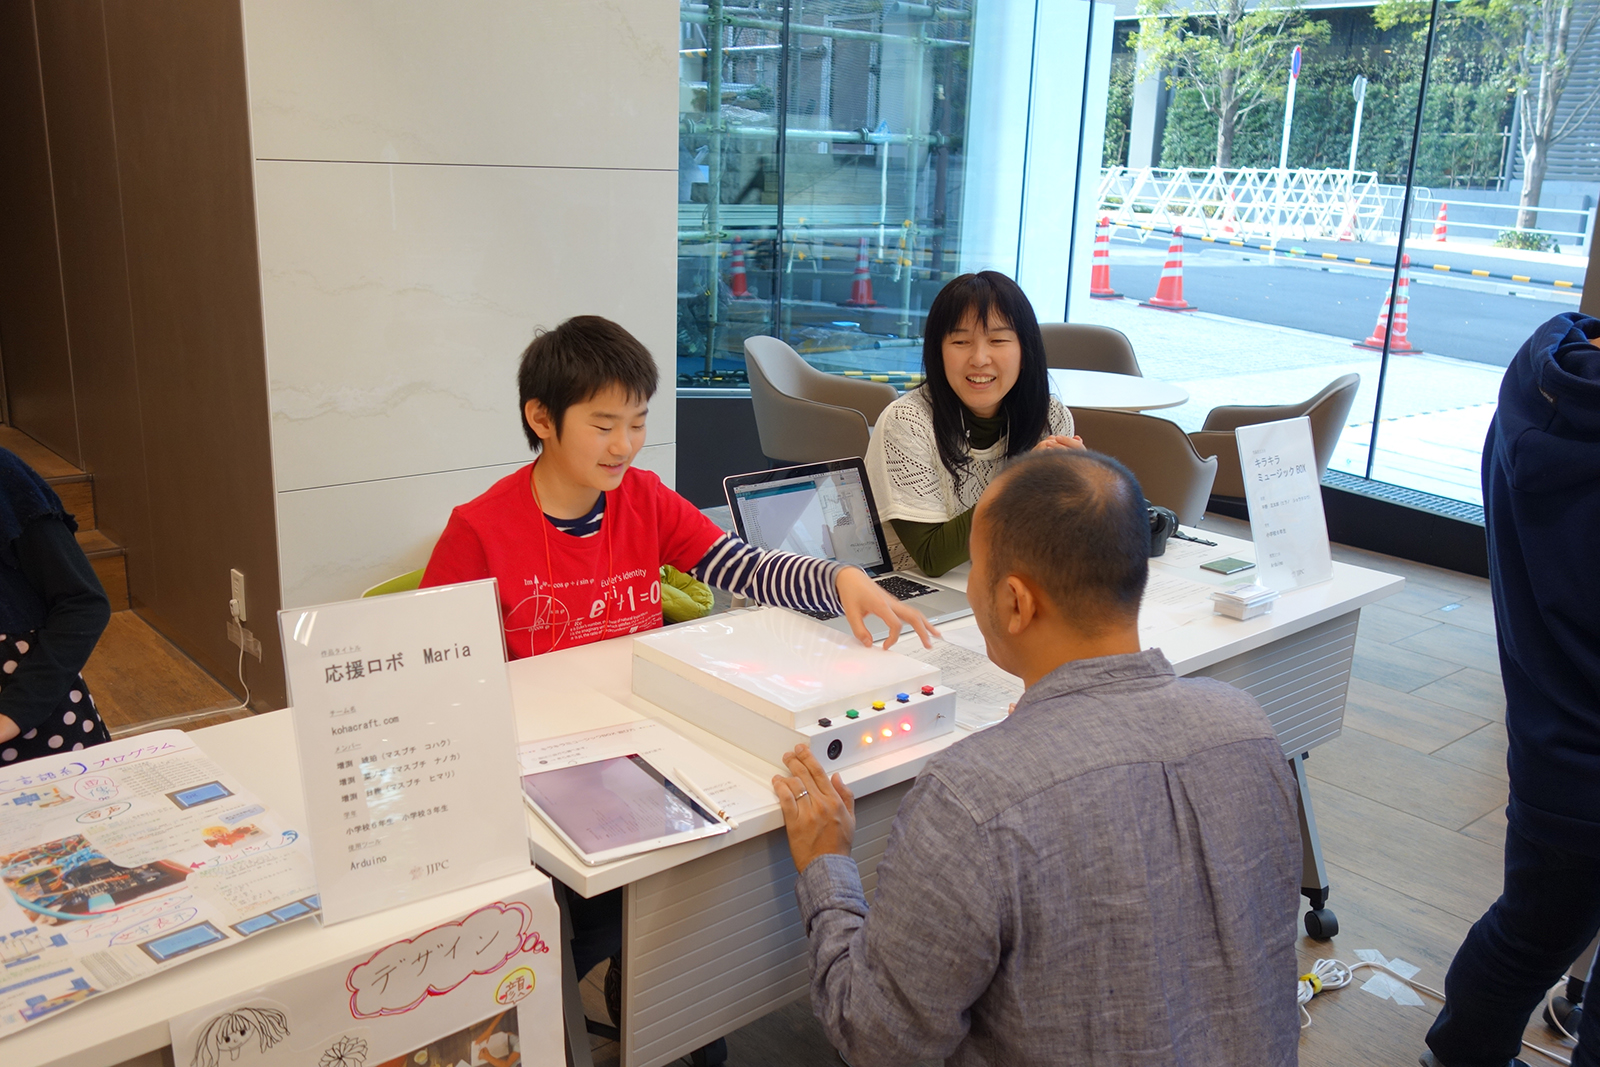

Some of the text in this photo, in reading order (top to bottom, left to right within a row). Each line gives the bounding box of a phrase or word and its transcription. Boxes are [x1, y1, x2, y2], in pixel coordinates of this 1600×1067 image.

[1255, 455, 1280, 468] キラキラ
[325, 643, 471, 684] 応援ロボ Maria
[331, 716, 400, 736] kohacraft.com
[350, 855, 388, 871] Arduino
[371, 930, 500, 995] デザイン
